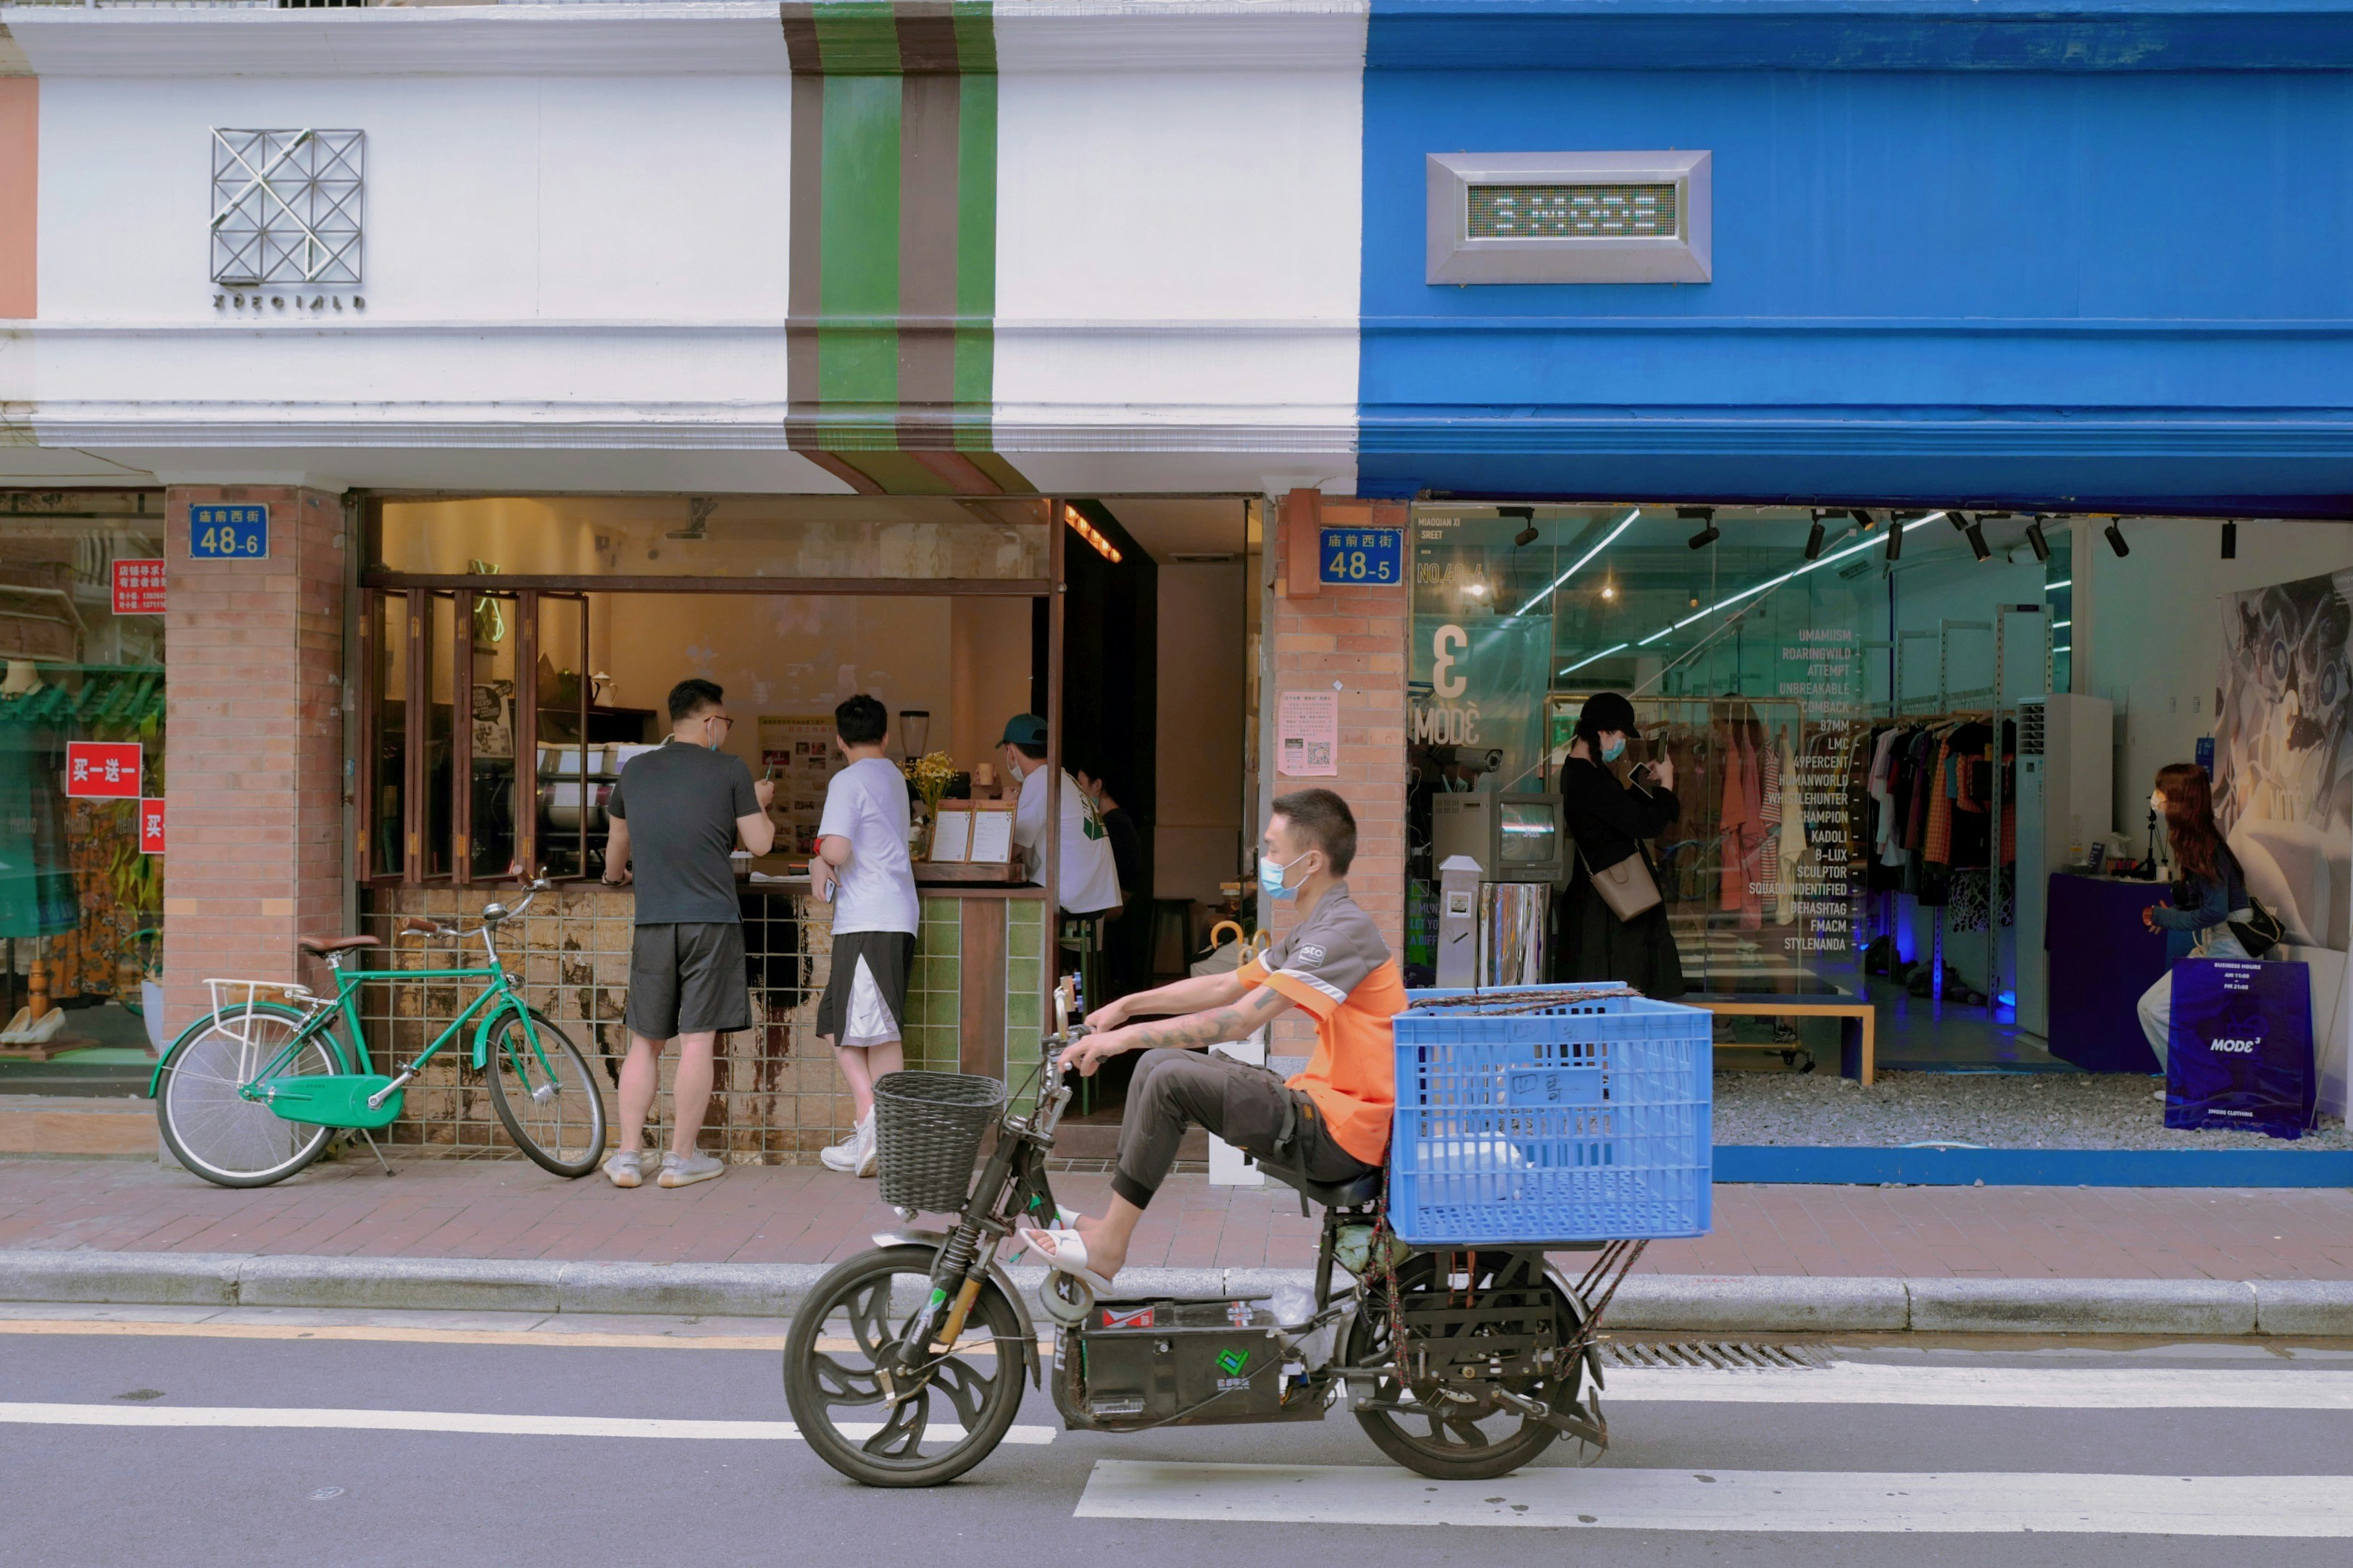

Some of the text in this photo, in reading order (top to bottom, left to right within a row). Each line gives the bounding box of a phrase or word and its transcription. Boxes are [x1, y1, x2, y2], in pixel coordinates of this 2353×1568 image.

[199, 510, 259, 522] 庙前西街
[1418, 517, 1460, 527] MIAOQIAN XI
[200, 527, 258, 554] 48-6
[1421, 530, 1443, 539] SREET
[1328, 535, 1392, 548] 庙前西街
[1328, 551, 1391, 580] 48-5
[1783, 648, 1851, 660] ROARINGWILD
[1807, 664, 1849, 676] ATTEMPT
[1780, 683, 1849, 695] UNBREAKABLE
[1802, 701, 1849, 713] COMBACK
[1820, 720, 1849, 731] 87MM
[1828, 738, 1849, 750] LMC
[1793, 756, 1849, 768] 49PERCENT
[73, 758, 136, 783] 买一送一
[1779, 774, 1848, 787] HUMANWORLD
[1767, 793, 1848, 805] WHISTLEHUNTER
[1797, 811, 1848, 823] CHAMPION
[146, 814, 165, 838] 买
[1811, 830, 1847, 843] KADOLI
[1815, 849, 1847, 862] B-LUX
[1797, 866, 1847, 878] SCULPTOR
[1749, 882, 1847, 896] SQUADUNIDENTIFIED
[1791, 901, 1846, 915] DEHASHTAG
[1410, 919, 1425, 930] LET
[1810, 919, 1846, 932] FMACM
[1784, 938, 1846, 951] STYLENANDA
